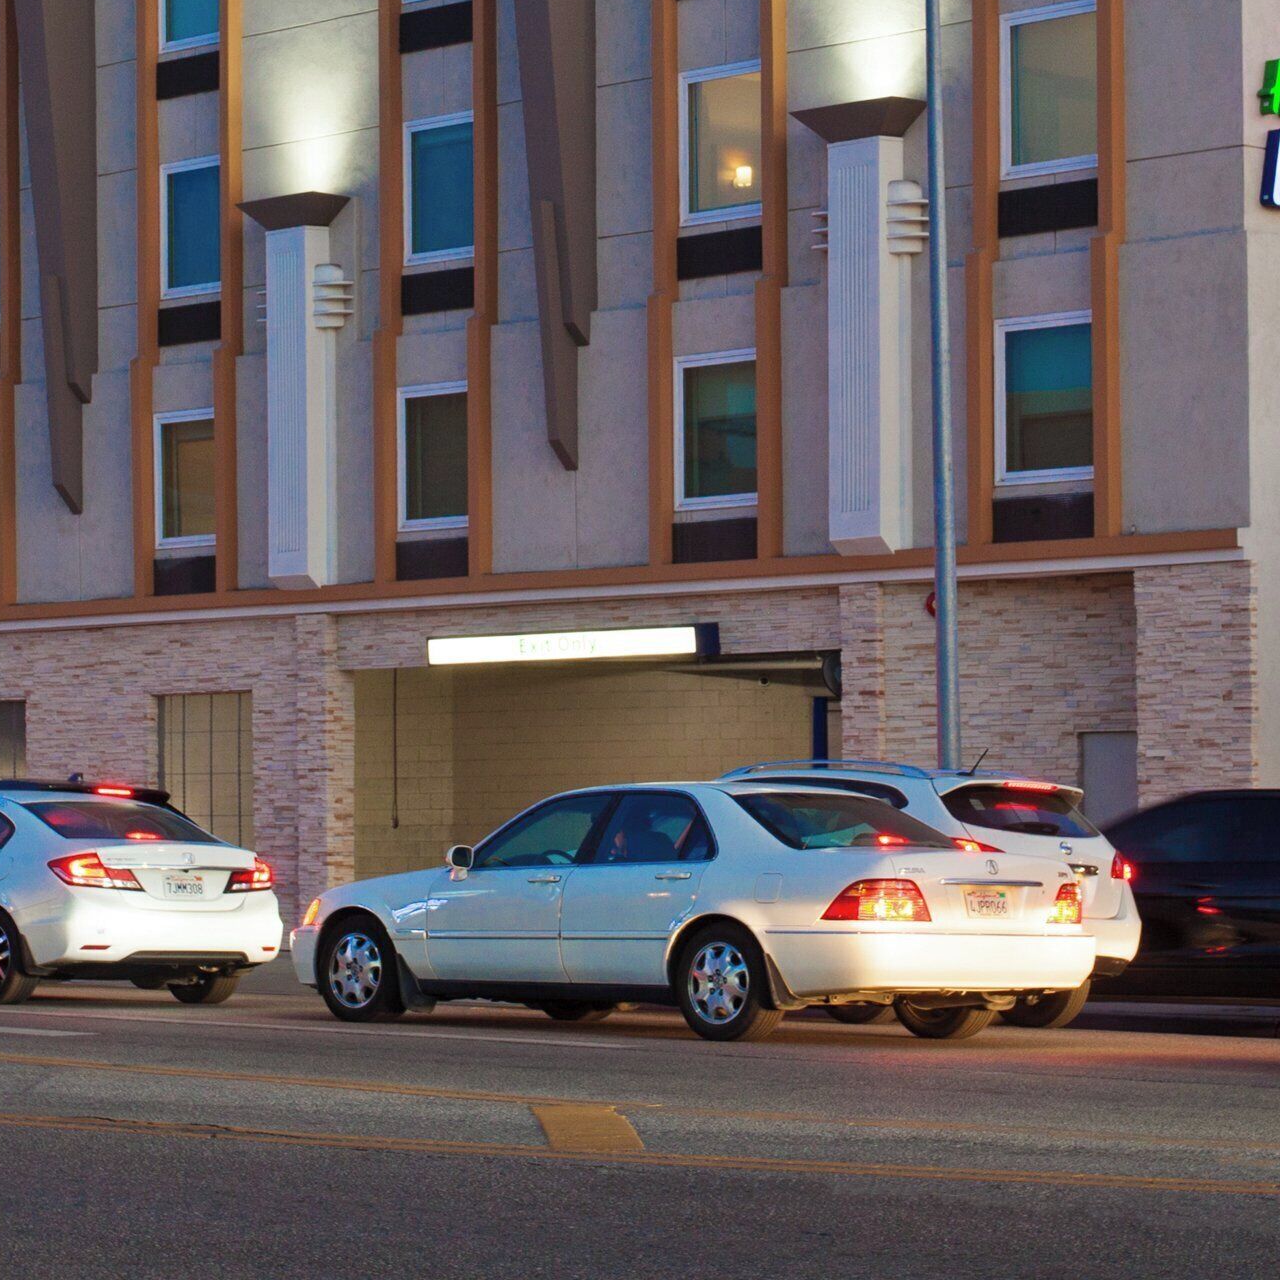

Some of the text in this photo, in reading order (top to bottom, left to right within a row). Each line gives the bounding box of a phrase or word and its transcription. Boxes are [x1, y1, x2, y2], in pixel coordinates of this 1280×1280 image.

[519, 634, 596, 655] Exit Only
[166, 882, 203, 895] 7JMM308
